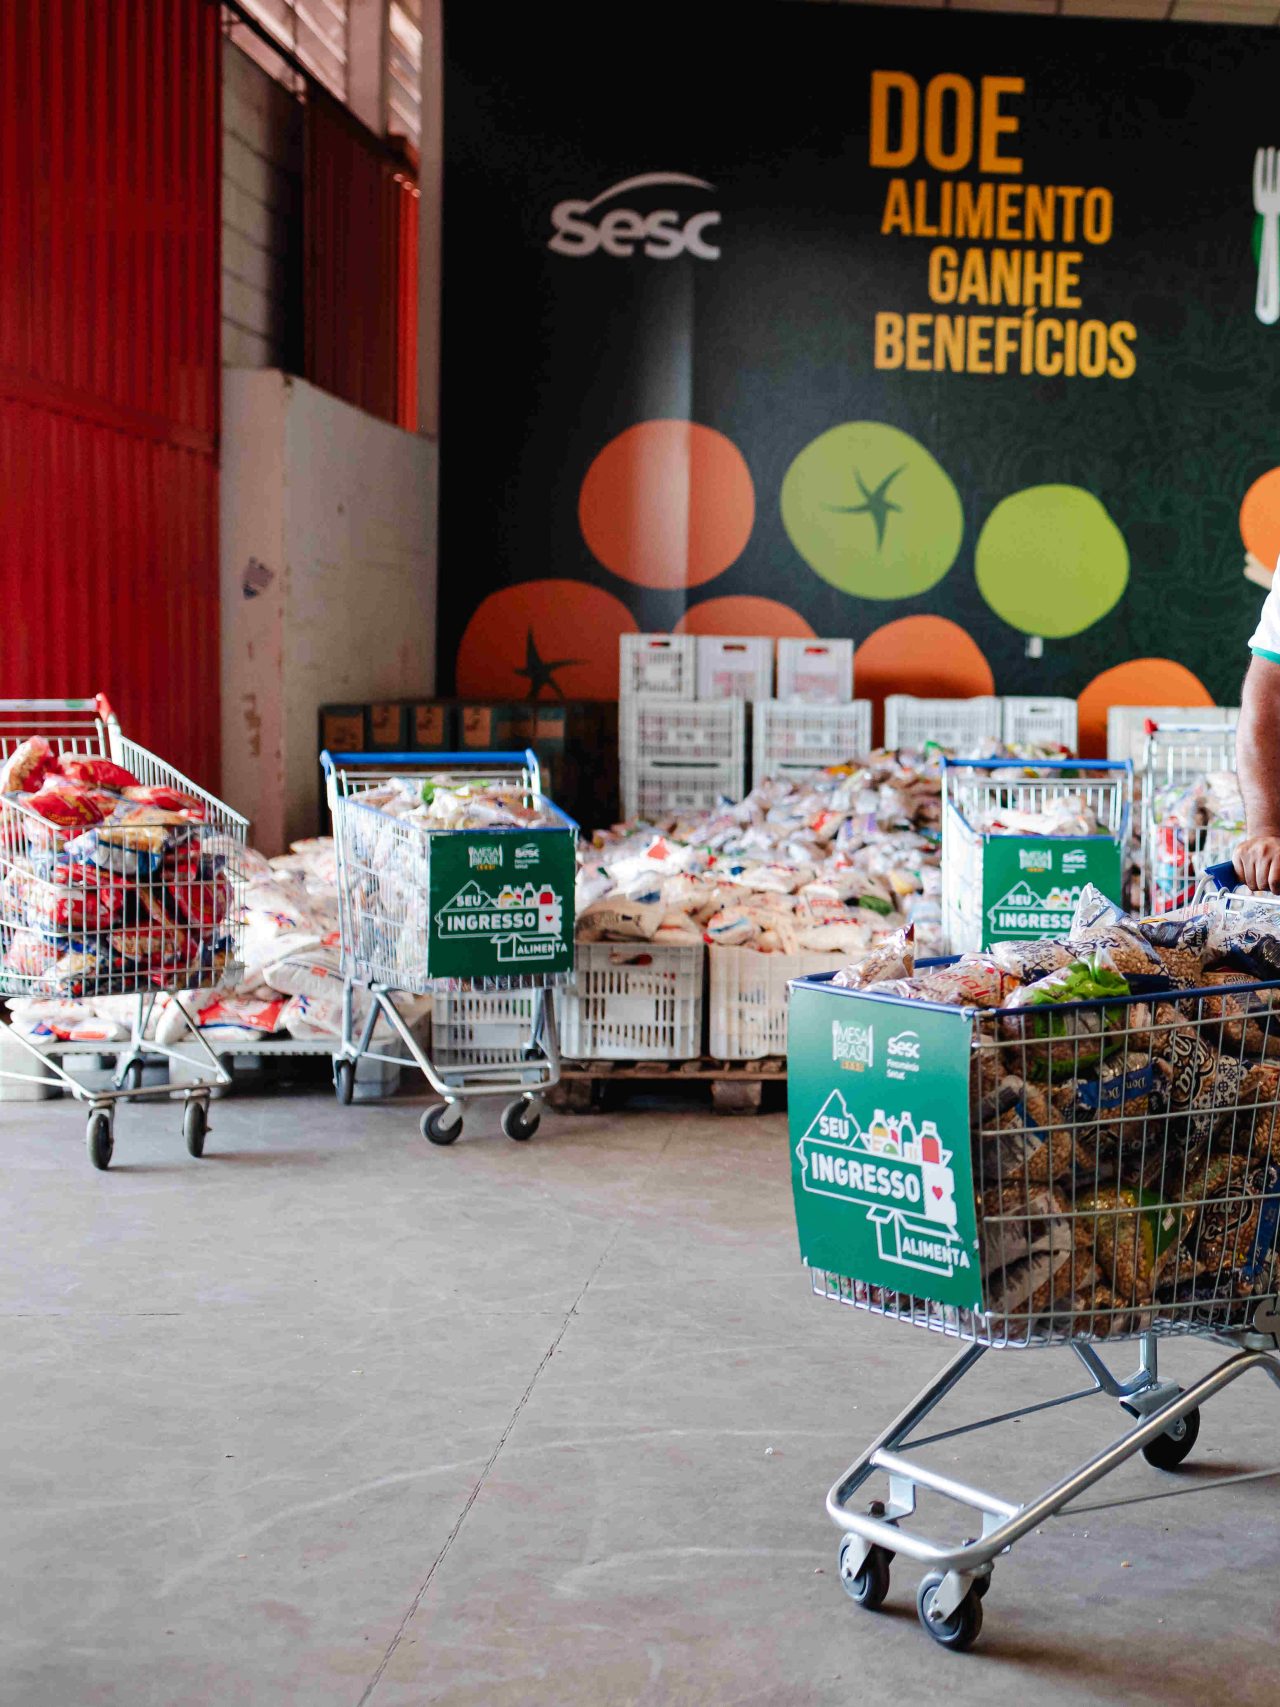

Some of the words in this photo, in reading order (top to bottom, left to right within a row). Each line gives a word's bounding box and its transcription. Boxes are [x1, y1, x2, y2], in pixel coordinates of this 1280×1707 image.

[870, 71, 1024, 174] DOE
[881, 180, 1113, 244] ALIMENTO
[548, 199, 721, 259] Sesc
[928, 246, 1083, 309] GANHE
[874, 306, 1137, 379] BENEFÍCIOS
[457, 895, 482, 907] SEU
[1008, 894, 1032, 906] SEU
[447, 913, 536, 931] INGRESSO
[1000, 913, 1076, 928] INGRESS
[517, 943, 568, 954] ALIMENTA
[887, 1036, 920, 1059] Sesc
[819, 1116, 850, 1140] SEU
[811, 1151, 921, 1203] INGRESSO
[902, 1236, 971, 1269] ALIMENTA
